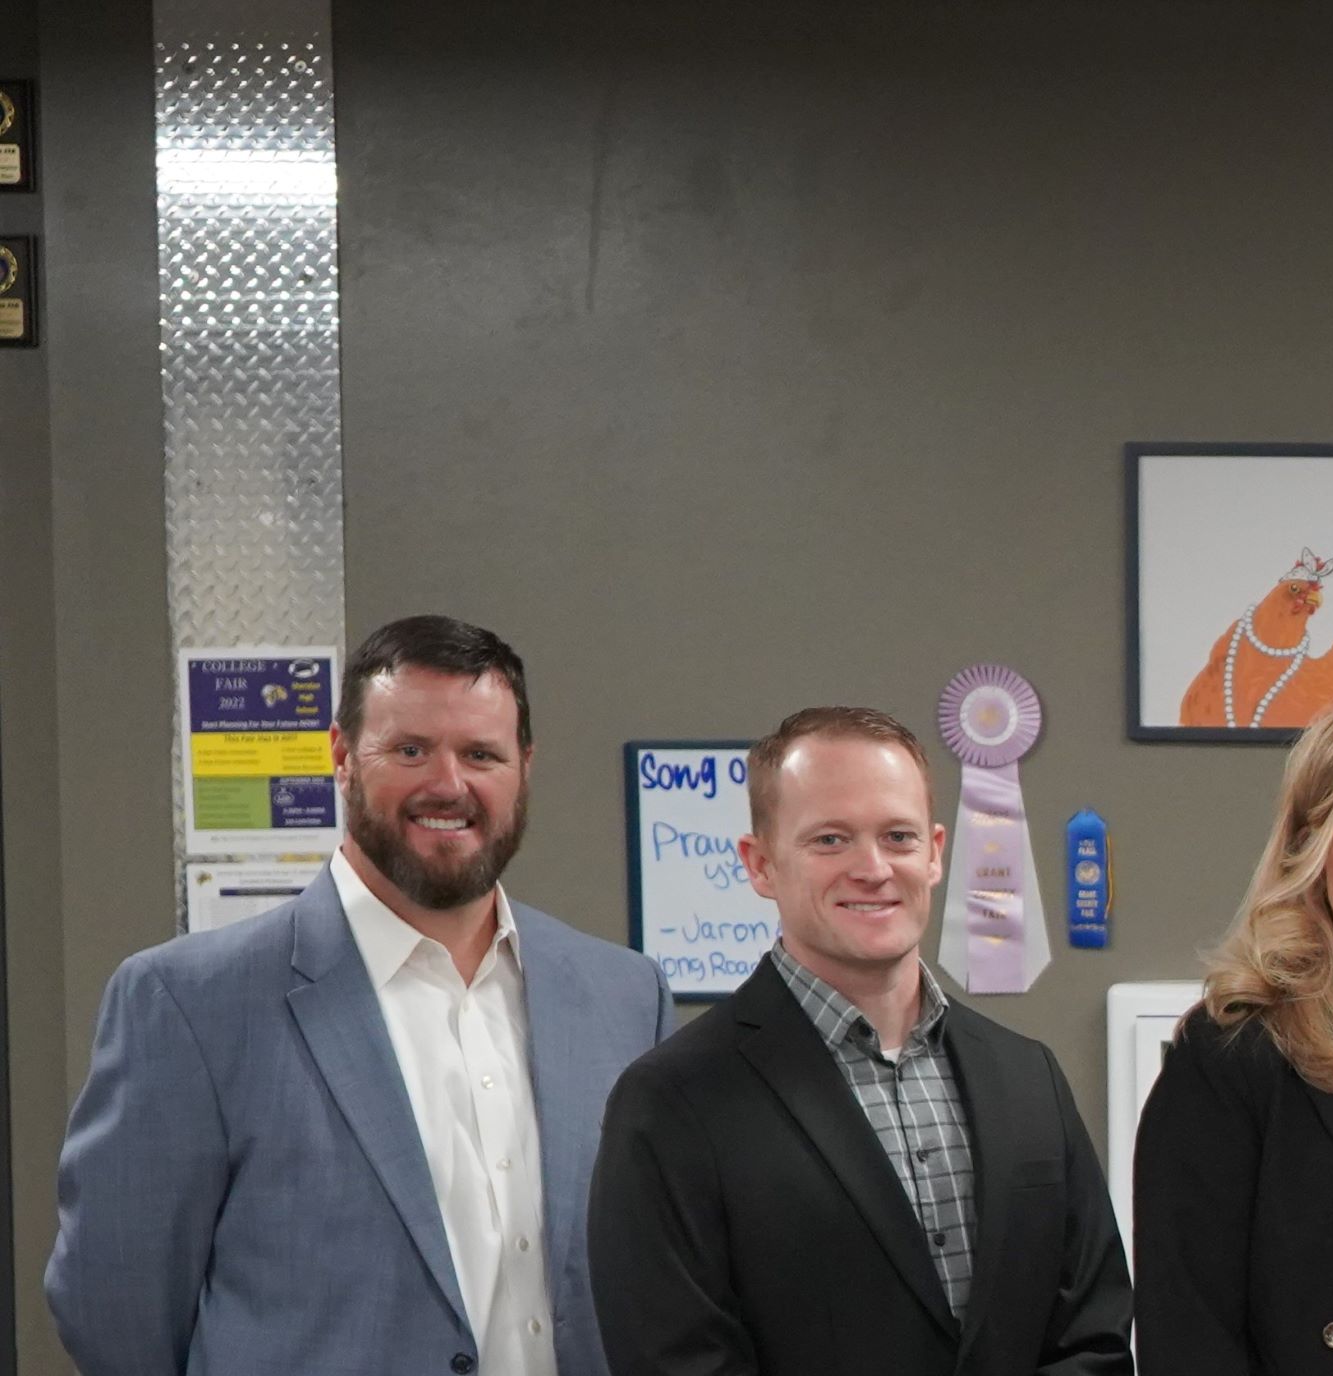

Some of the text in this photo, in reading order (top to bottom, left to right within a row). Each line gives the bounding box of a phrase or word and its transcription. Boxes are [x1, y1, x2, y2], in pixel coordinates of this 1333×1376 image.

[201, 660, 266, 673] COLLEGE
[215, 678, 247, 691] FAIR
[219, 697, 245, 710] 2022
[641, 753, 748, 798] Song o
[653, 822, 741, 866] Pray
[975, 866, 1012, 878] GRANT
